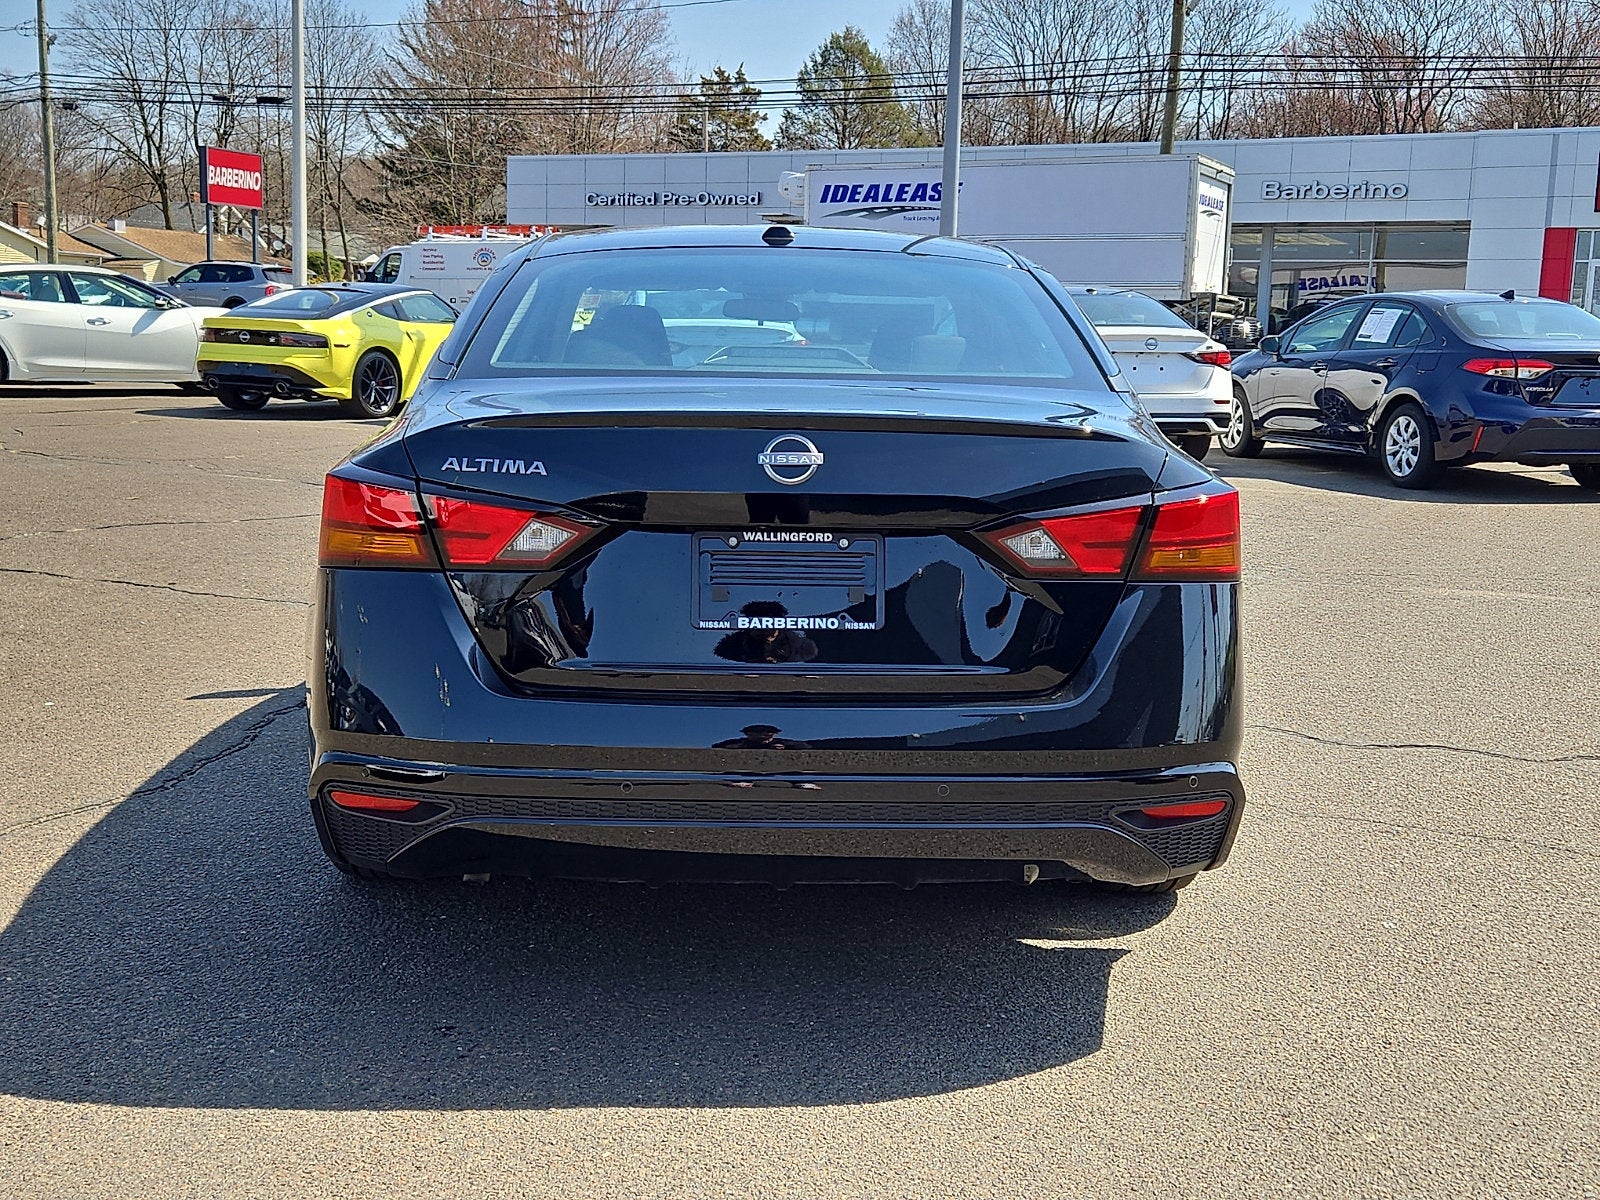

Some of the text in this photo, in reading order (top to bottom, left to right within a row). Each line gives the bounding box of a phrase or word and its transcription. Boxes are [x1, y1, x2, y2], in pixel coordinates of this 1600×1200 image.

[208, 164, 261, 191] BARBERINO
[1261, 180, 1408, 200] Barberino
[585, 191, 761, 206] Certified Pre-Owned
[759, 454, 821, 463] NISSAN
[440, 457, 548, 476] ALTIMA
[742, 531, 833, 542] WALLINGFORD
[699, 616, 876, 630] NISSAN BARBERINO NISSAN
